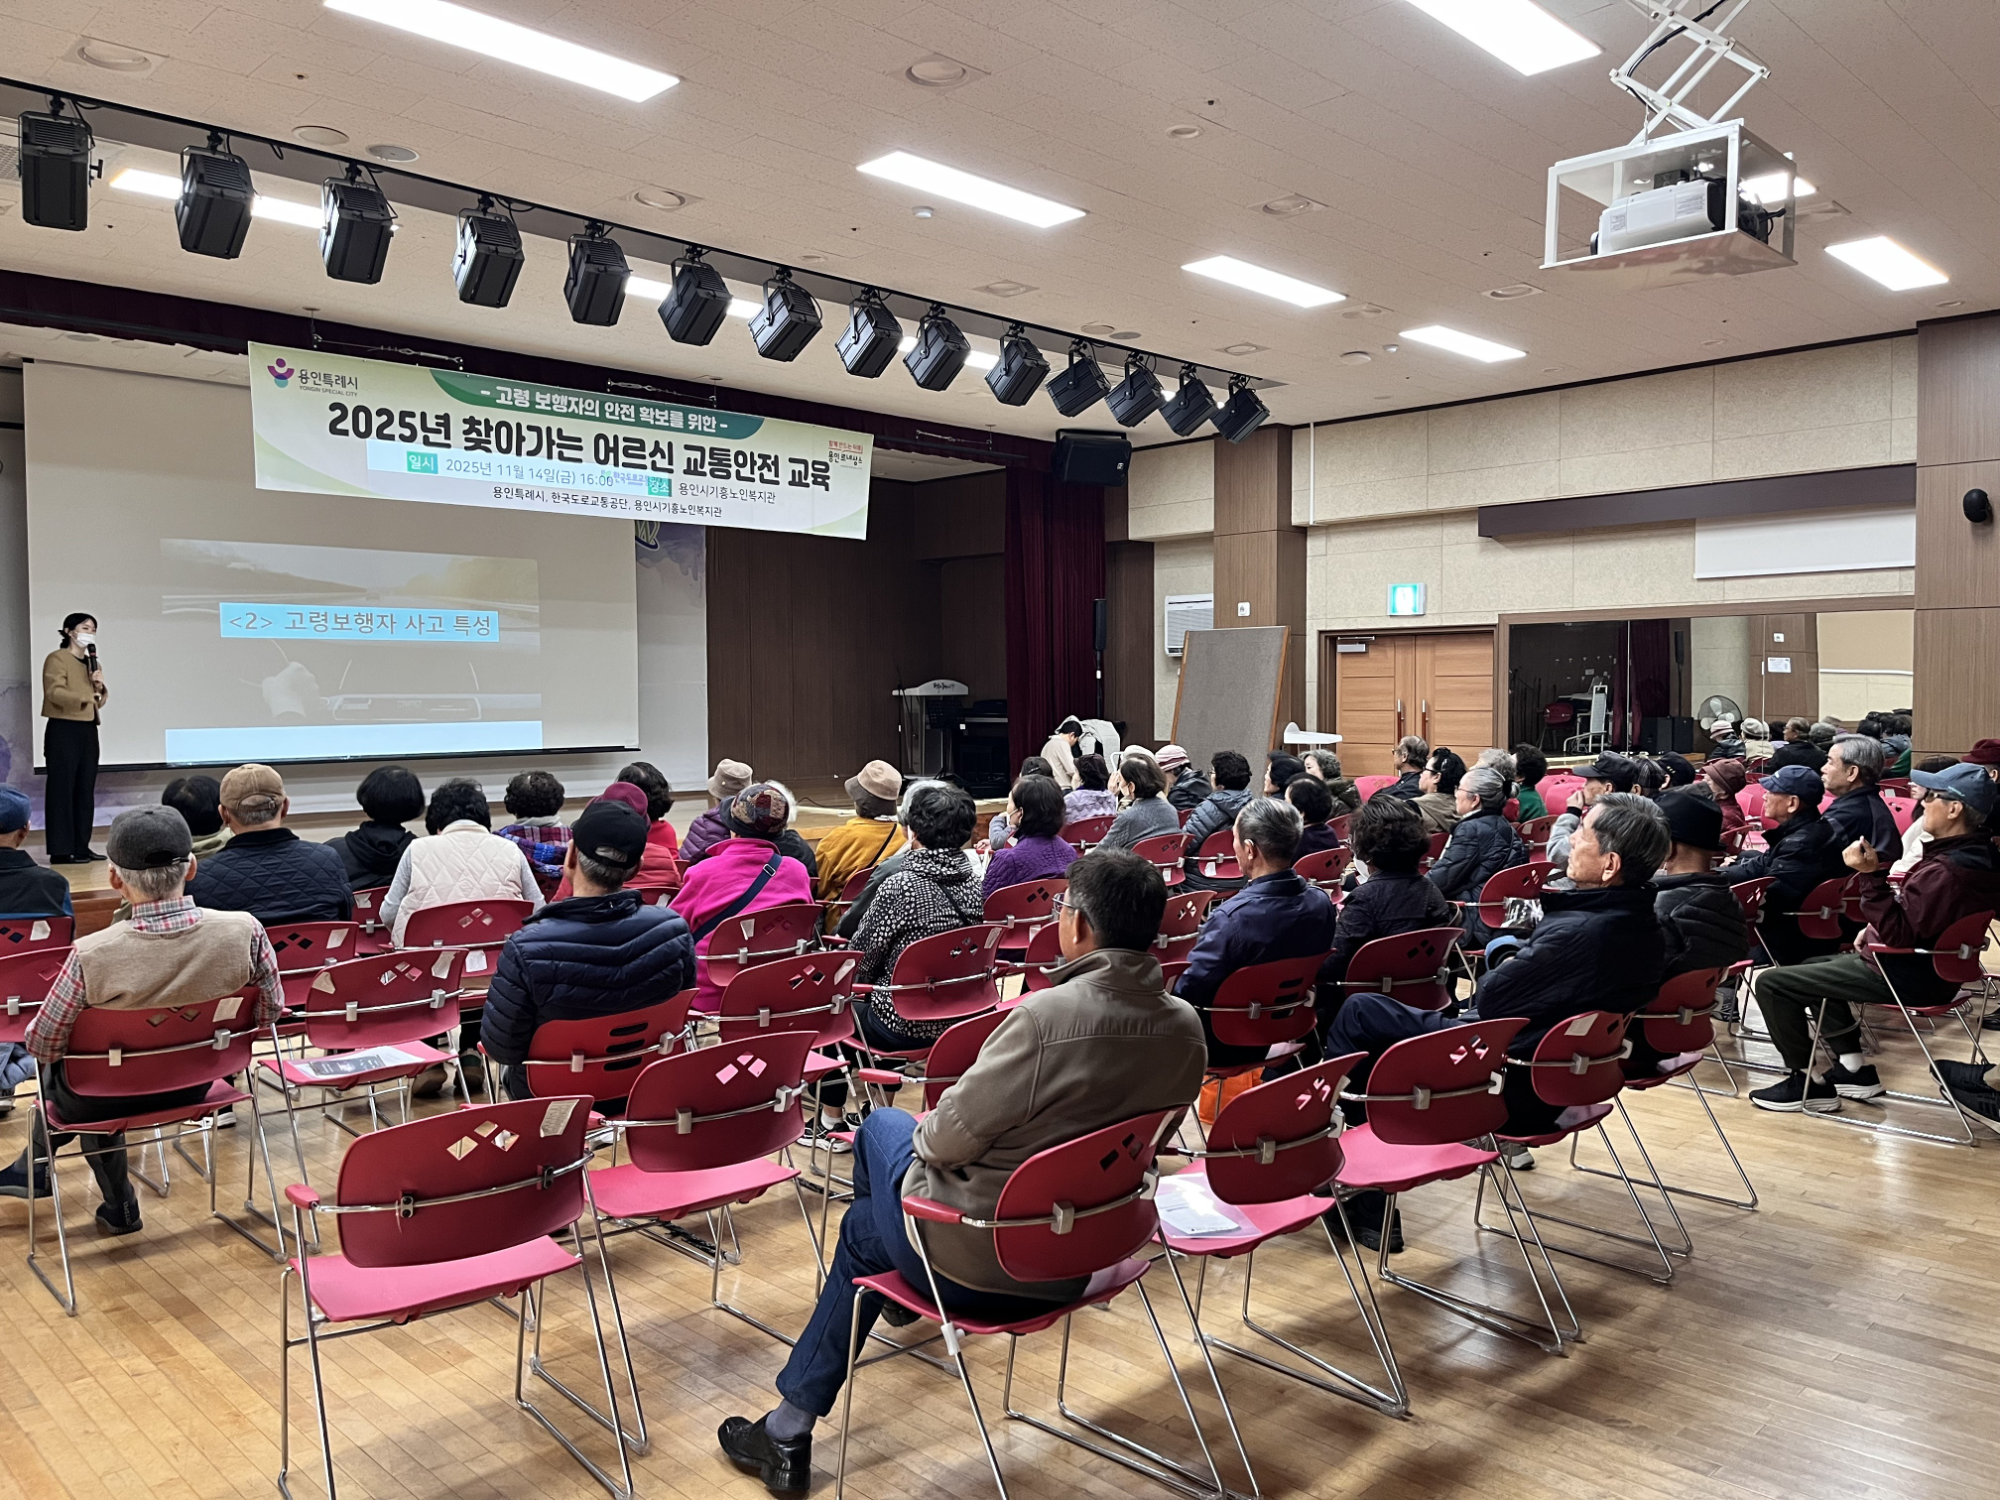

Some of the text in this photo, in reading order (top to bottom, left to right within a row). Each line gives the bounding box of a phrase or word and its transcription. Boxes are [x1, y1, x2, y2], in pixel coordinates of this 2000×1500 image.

[298, 369, 358, 390] 용인특례시
[321, 388, 345, 396] SPECIAL
[496, 386, 530, 408] 고령
[535, 391, 600, 418] 보행자의
[604, 402, 636, 422] 안전
[639, 406, 684, 429] 확보를
[688, 413, 717, 433] 위한
[328, 402, 831, 492] 2025년 찾아가는 어르신 교통안전 교육
[828, 451, 840, 463] 용인
[408, 454, 435, 471] 일시
[446, 459, 492, 476] 2025년
[497, 464, 524, 480] 11월
[528, 467, 576, 485] 14일(금)
[580, 473, 614, 487] 16:00
[492, 486, 722, 517] 용인특례시, 한국도로교통공단, 용인시기흥노인복지관
[650, 478, 776, 504] 장소 용인시기흥노인복지관
[228, 611, 491, 637] <2> 고령보행자 사고 특성
